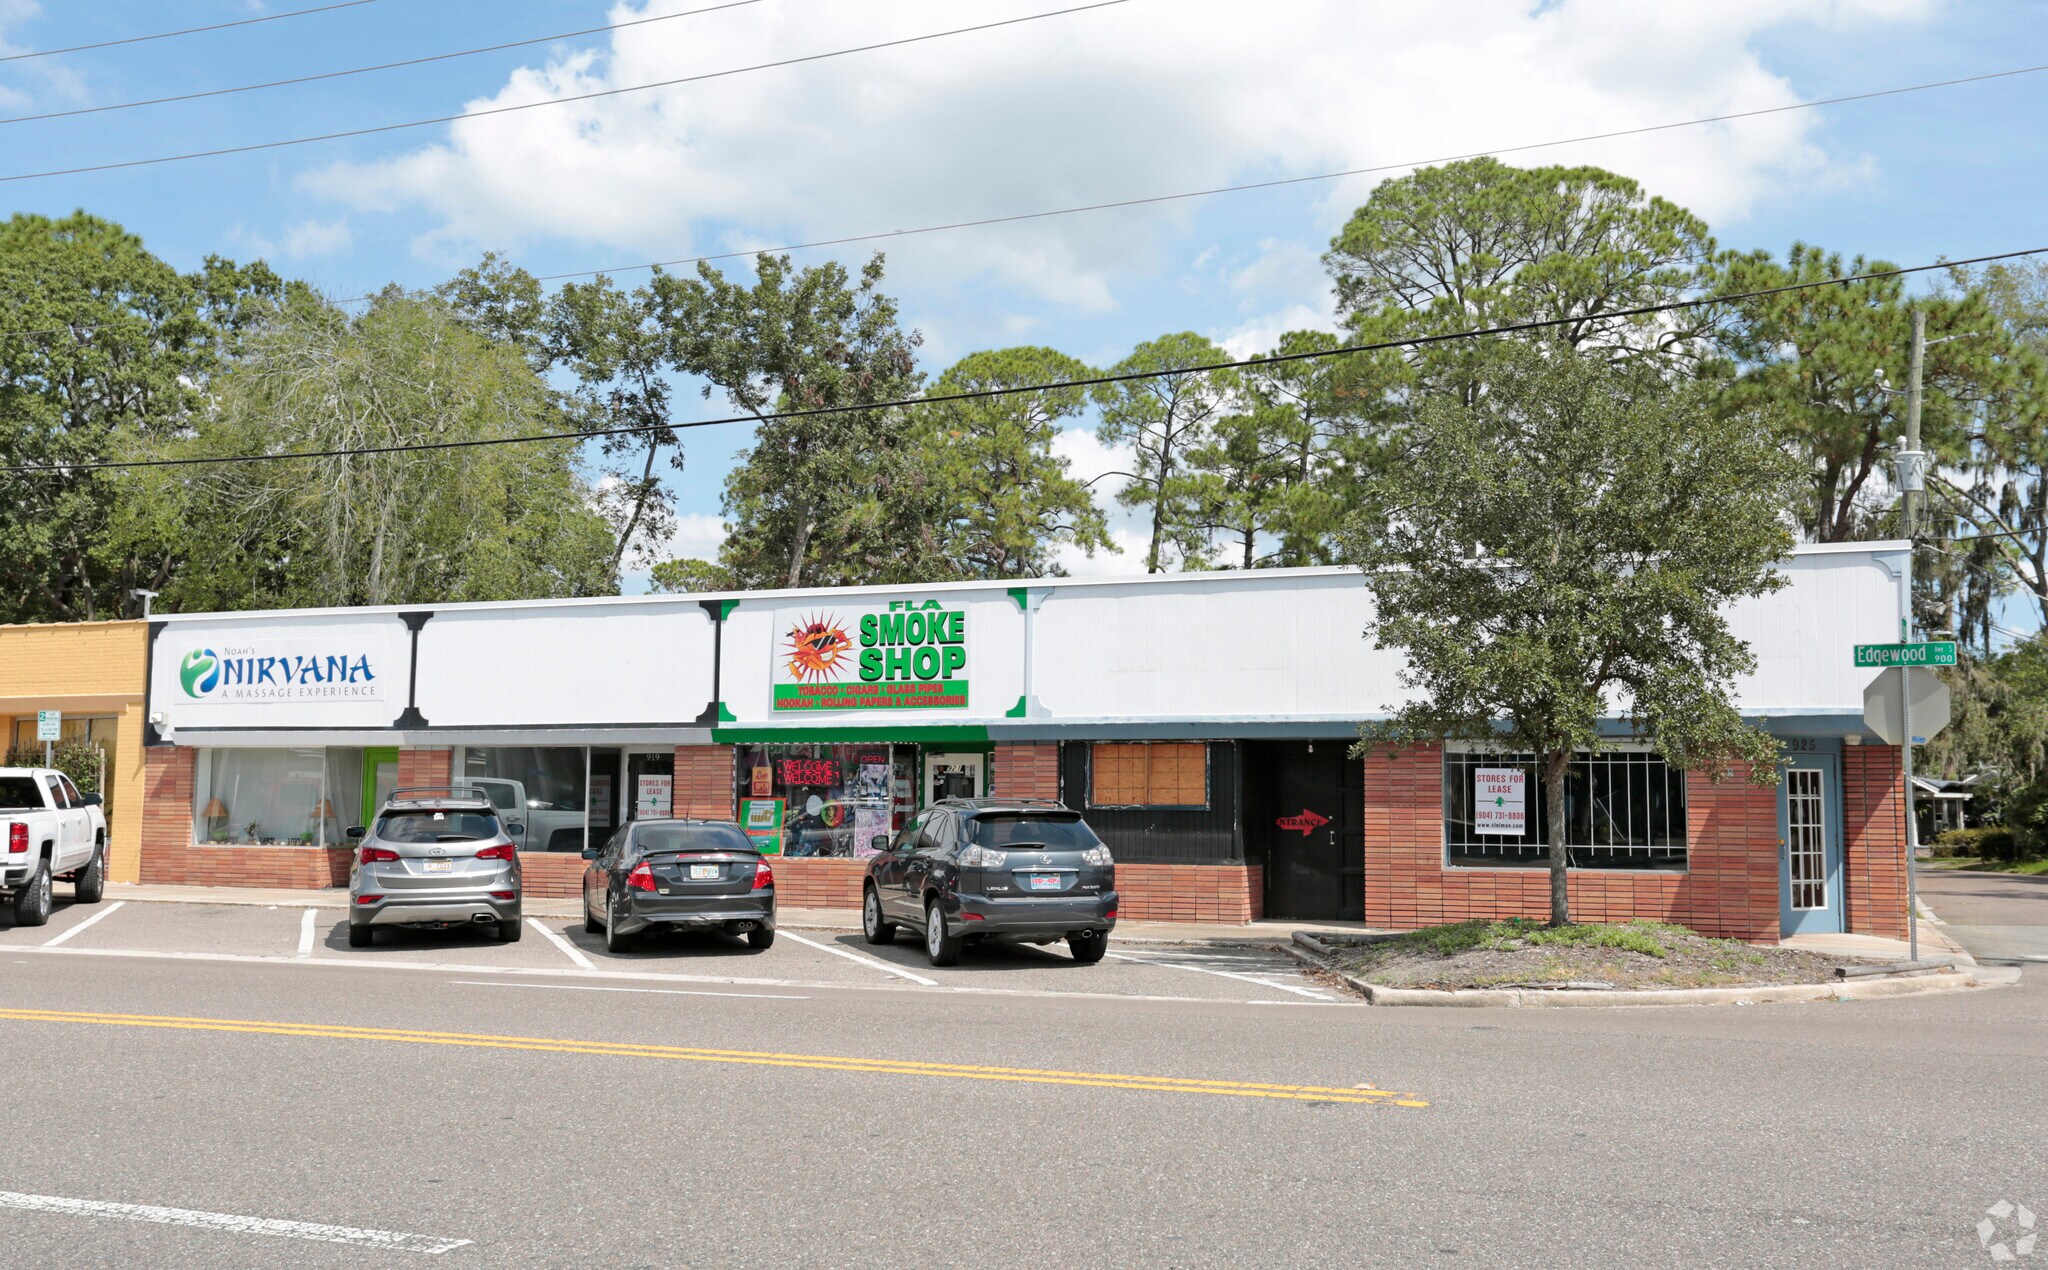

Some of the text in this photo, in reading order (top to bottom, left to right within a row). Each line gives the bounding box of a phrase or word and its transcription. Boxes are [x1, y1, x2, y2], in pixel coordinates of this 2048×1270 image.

[889, 600, 943, 612] FLA
[860, 611, 965, 647] SMOKE
[1857, 645, 1927, 666] Edgewood
[1934, 654, 1953, 663] 900
[859, 646, 966, 681] SHOP
[223, 653, 376, 687] NIRVANA
[221, 686, 376, 699] A MASSAGE EXPERIENCE
[798, 682, 944, 696] TOBACCO CIGARS GLASS PIPES
[776, 695, 966, 709] HOOKAH ROLLING PAPERS & ACCESSORIES
[1792, 739, 1816, 751] 925
[646, 753, 660, 762] 919
[861, 755, 886, 763] OPEN
[783, 760, 833, 772] WELCOME
[783, 772, 833, 784] WELCOME
[1476, 775, 1524, 783] STORES FOR
[1488, 785, 1512, 793] LEASE
[1475, 811, 1524, 820] (904) 731-8806
